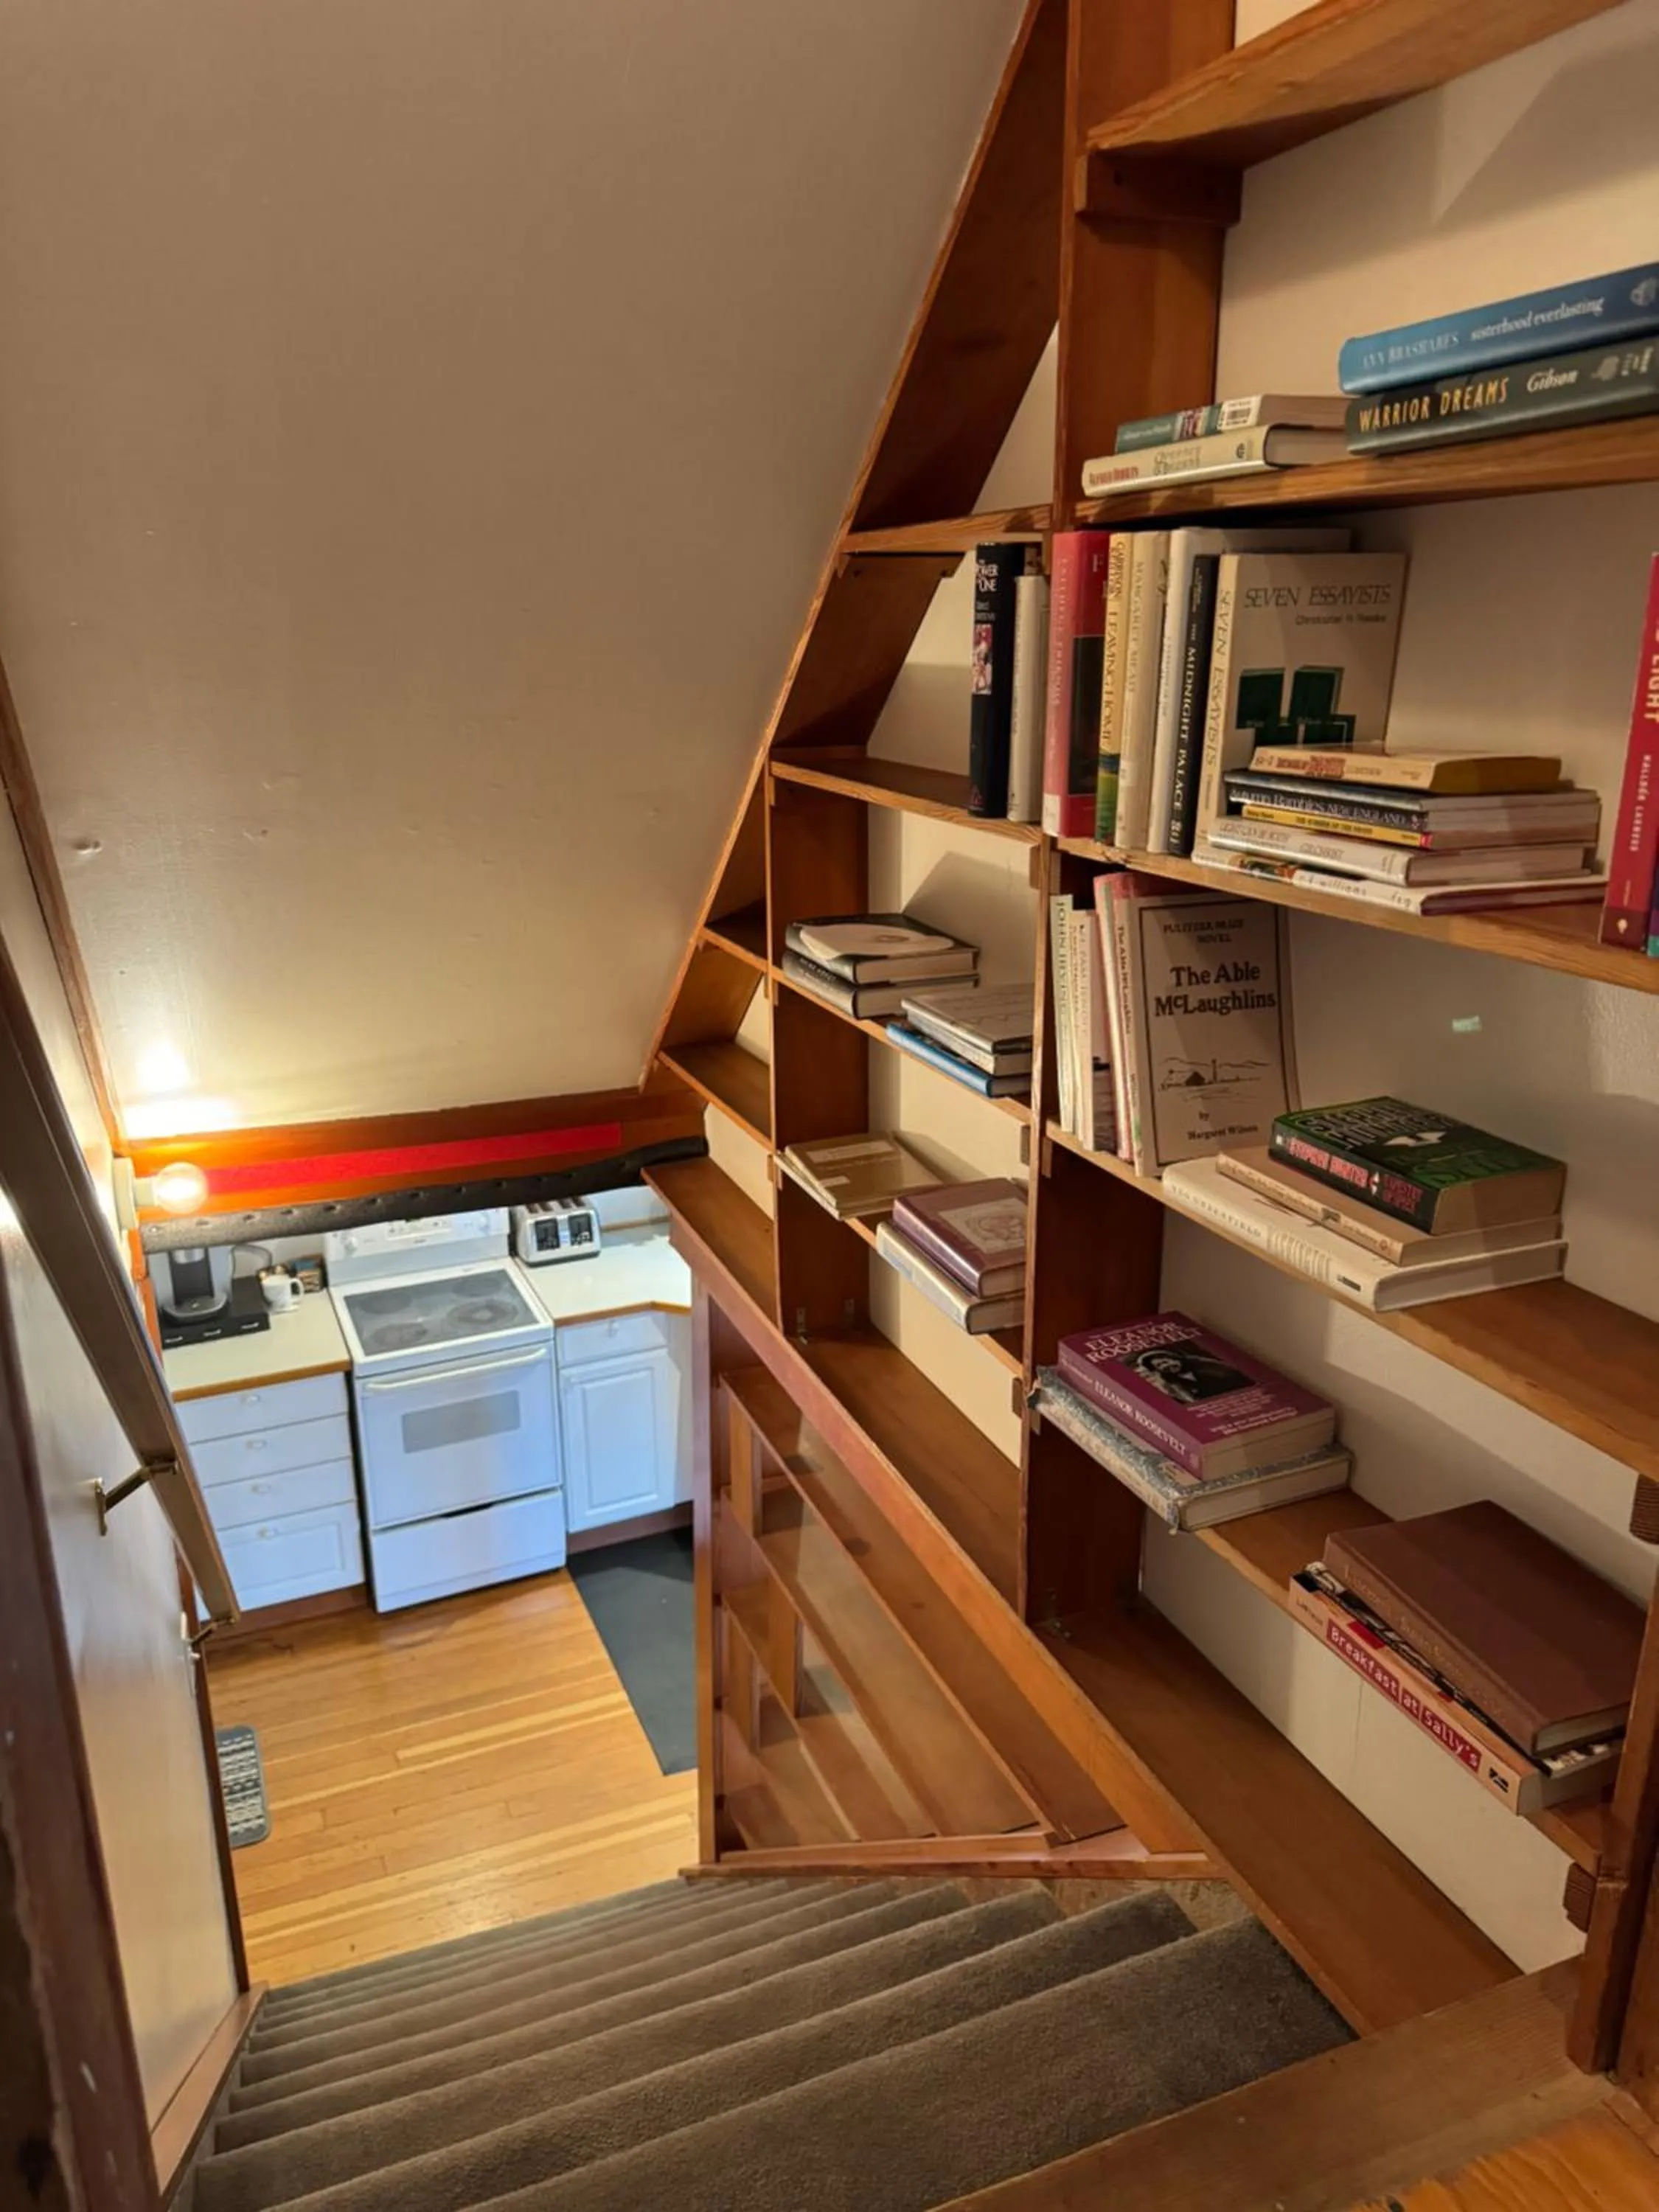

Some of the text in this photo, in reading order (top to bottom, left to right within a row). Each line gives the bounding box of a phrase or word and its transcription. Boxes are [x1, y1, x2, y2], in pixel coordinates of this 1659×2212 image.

[1470, 295, 1605, 342] sisterhood everlasting
[1526, 368, 1579, 395] Gibson
[1358, 377, 1510, 434] WARRIOR DREAMS
[1243, 582, 1392, 608] SEVEN ESSAYISTS
[1214, 590, 1231, 656] SEVEN
[1180, 646, 1196, 741] MIDNIGHT
[1172, 747, 1187, 811] PALACE
[1169, 960, 1261, 987] The Able
[1154, 989, 1276, 1018] McLaughlins
[1198, 1110, 1210, 1121] by
[1187, 1127, 1226, 1141] Margaret
[1085, 1321, 1178, 1351] ELEANOR
[1085, 1327, 1203, 1363] ROOSEVELT
[1093, 1379, 1133, 1416] ELEANOR
[1134, 1411, 1187, 1456] ROOSEVELT
[1329, 1626, 1398, 1694] Breakfast
[1402, 1691, 1419, 1714] at
[1423, 1707, 1479, 1767] Sally's
